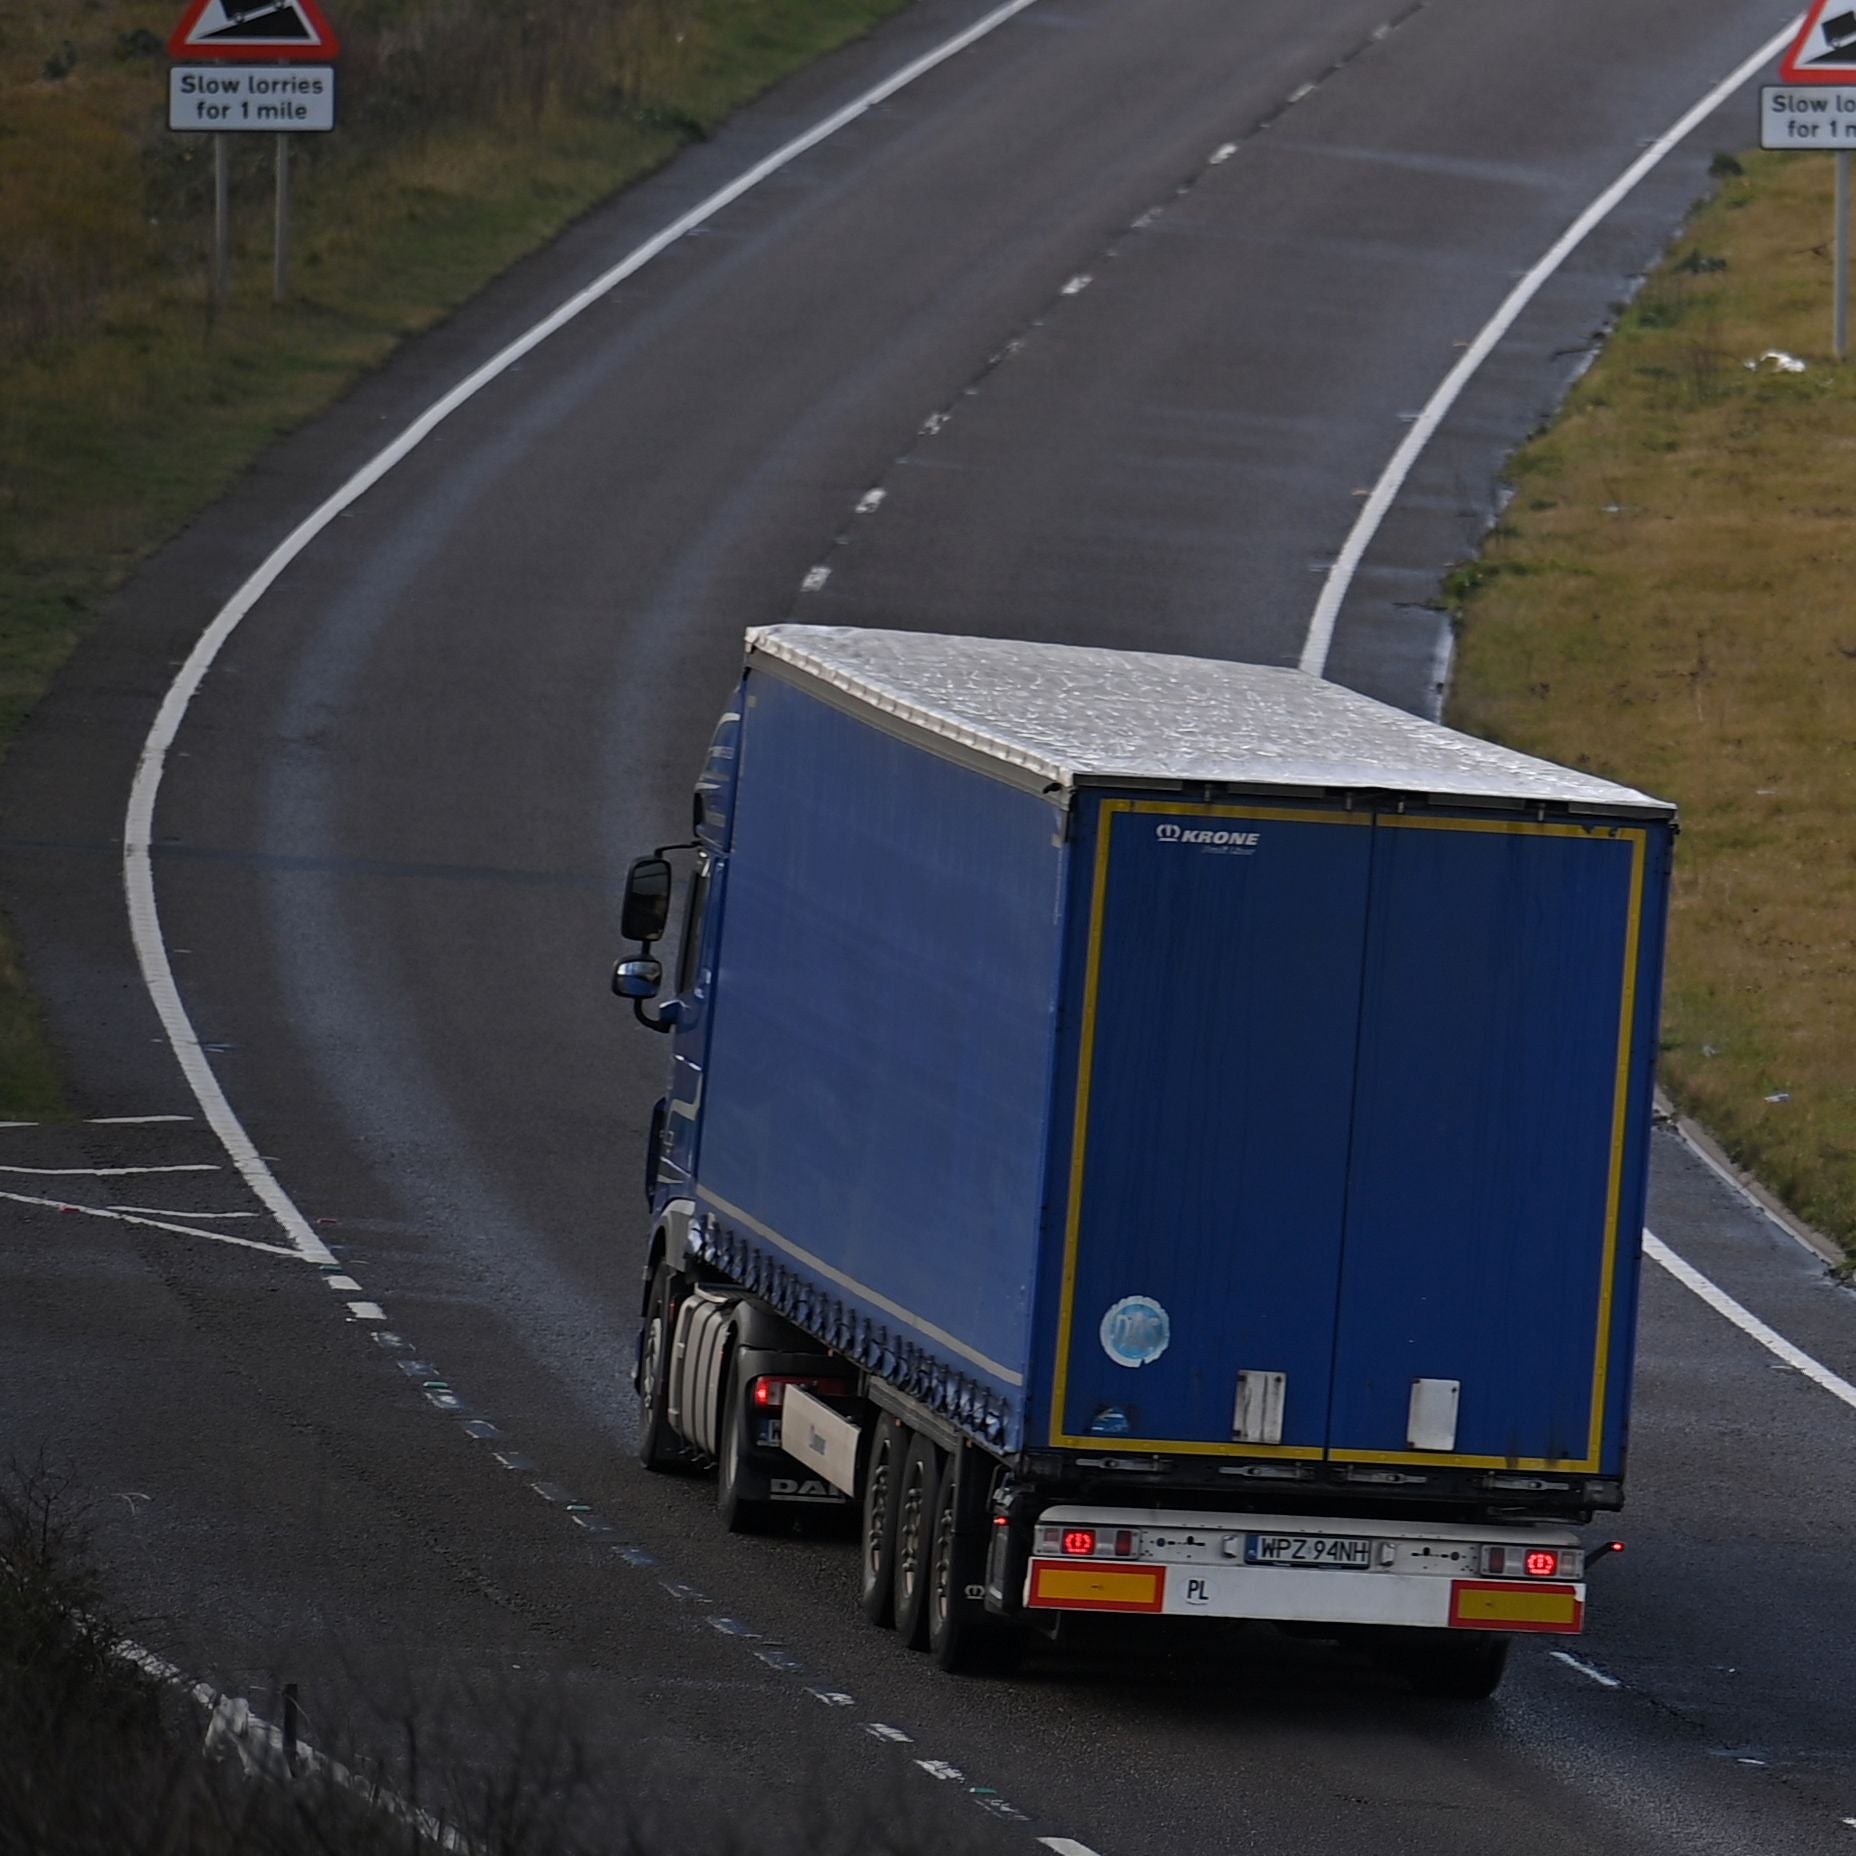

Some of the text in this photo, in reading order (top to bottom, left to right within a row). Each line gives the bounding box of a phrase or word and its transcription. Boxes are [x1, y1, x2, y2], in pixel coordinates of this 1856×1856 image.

[181, 75, 324, 94] Slow lorries
[197, 101, 308, 120] for 1 mile
[1771, 94, 1828, 113] Slow
[1787, 120, 1820, 138] for
[1830, 120, 1837, 138] 1
[1181, 830, 1260, 845] KRONE
[1261, 1537, 1369, 1562] WPZ 94NH
[1186, 1579, 1209, 1600] PL
